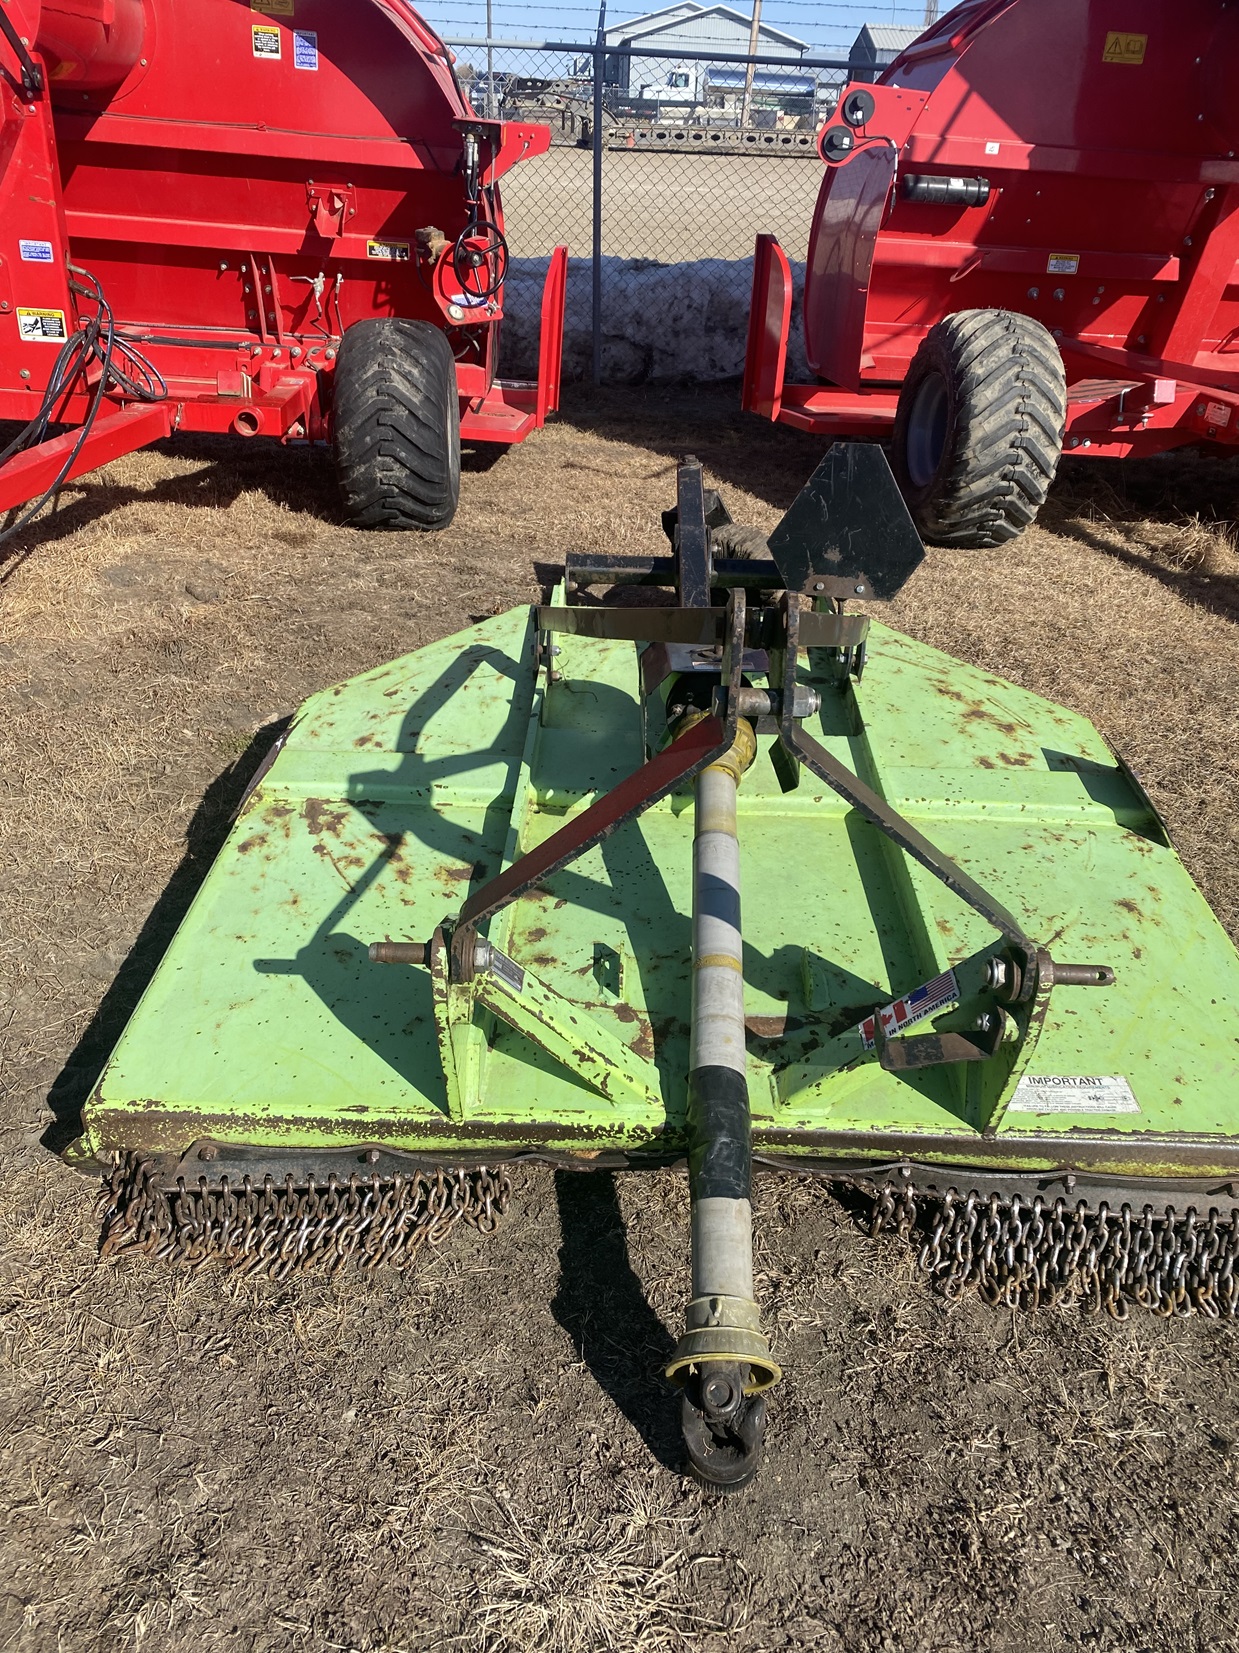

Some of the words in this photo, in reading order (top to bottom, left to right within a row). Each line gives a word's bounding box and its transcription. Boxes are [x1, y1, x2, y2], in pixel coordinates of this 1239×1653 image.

[888, 1027, 897, 1036] IN
[898, 1012, 922, 1030] NORTH
[923, 992, 958, 1016] AMERICA
[1028, 1076, 1103, 1086] IMPORTANT
